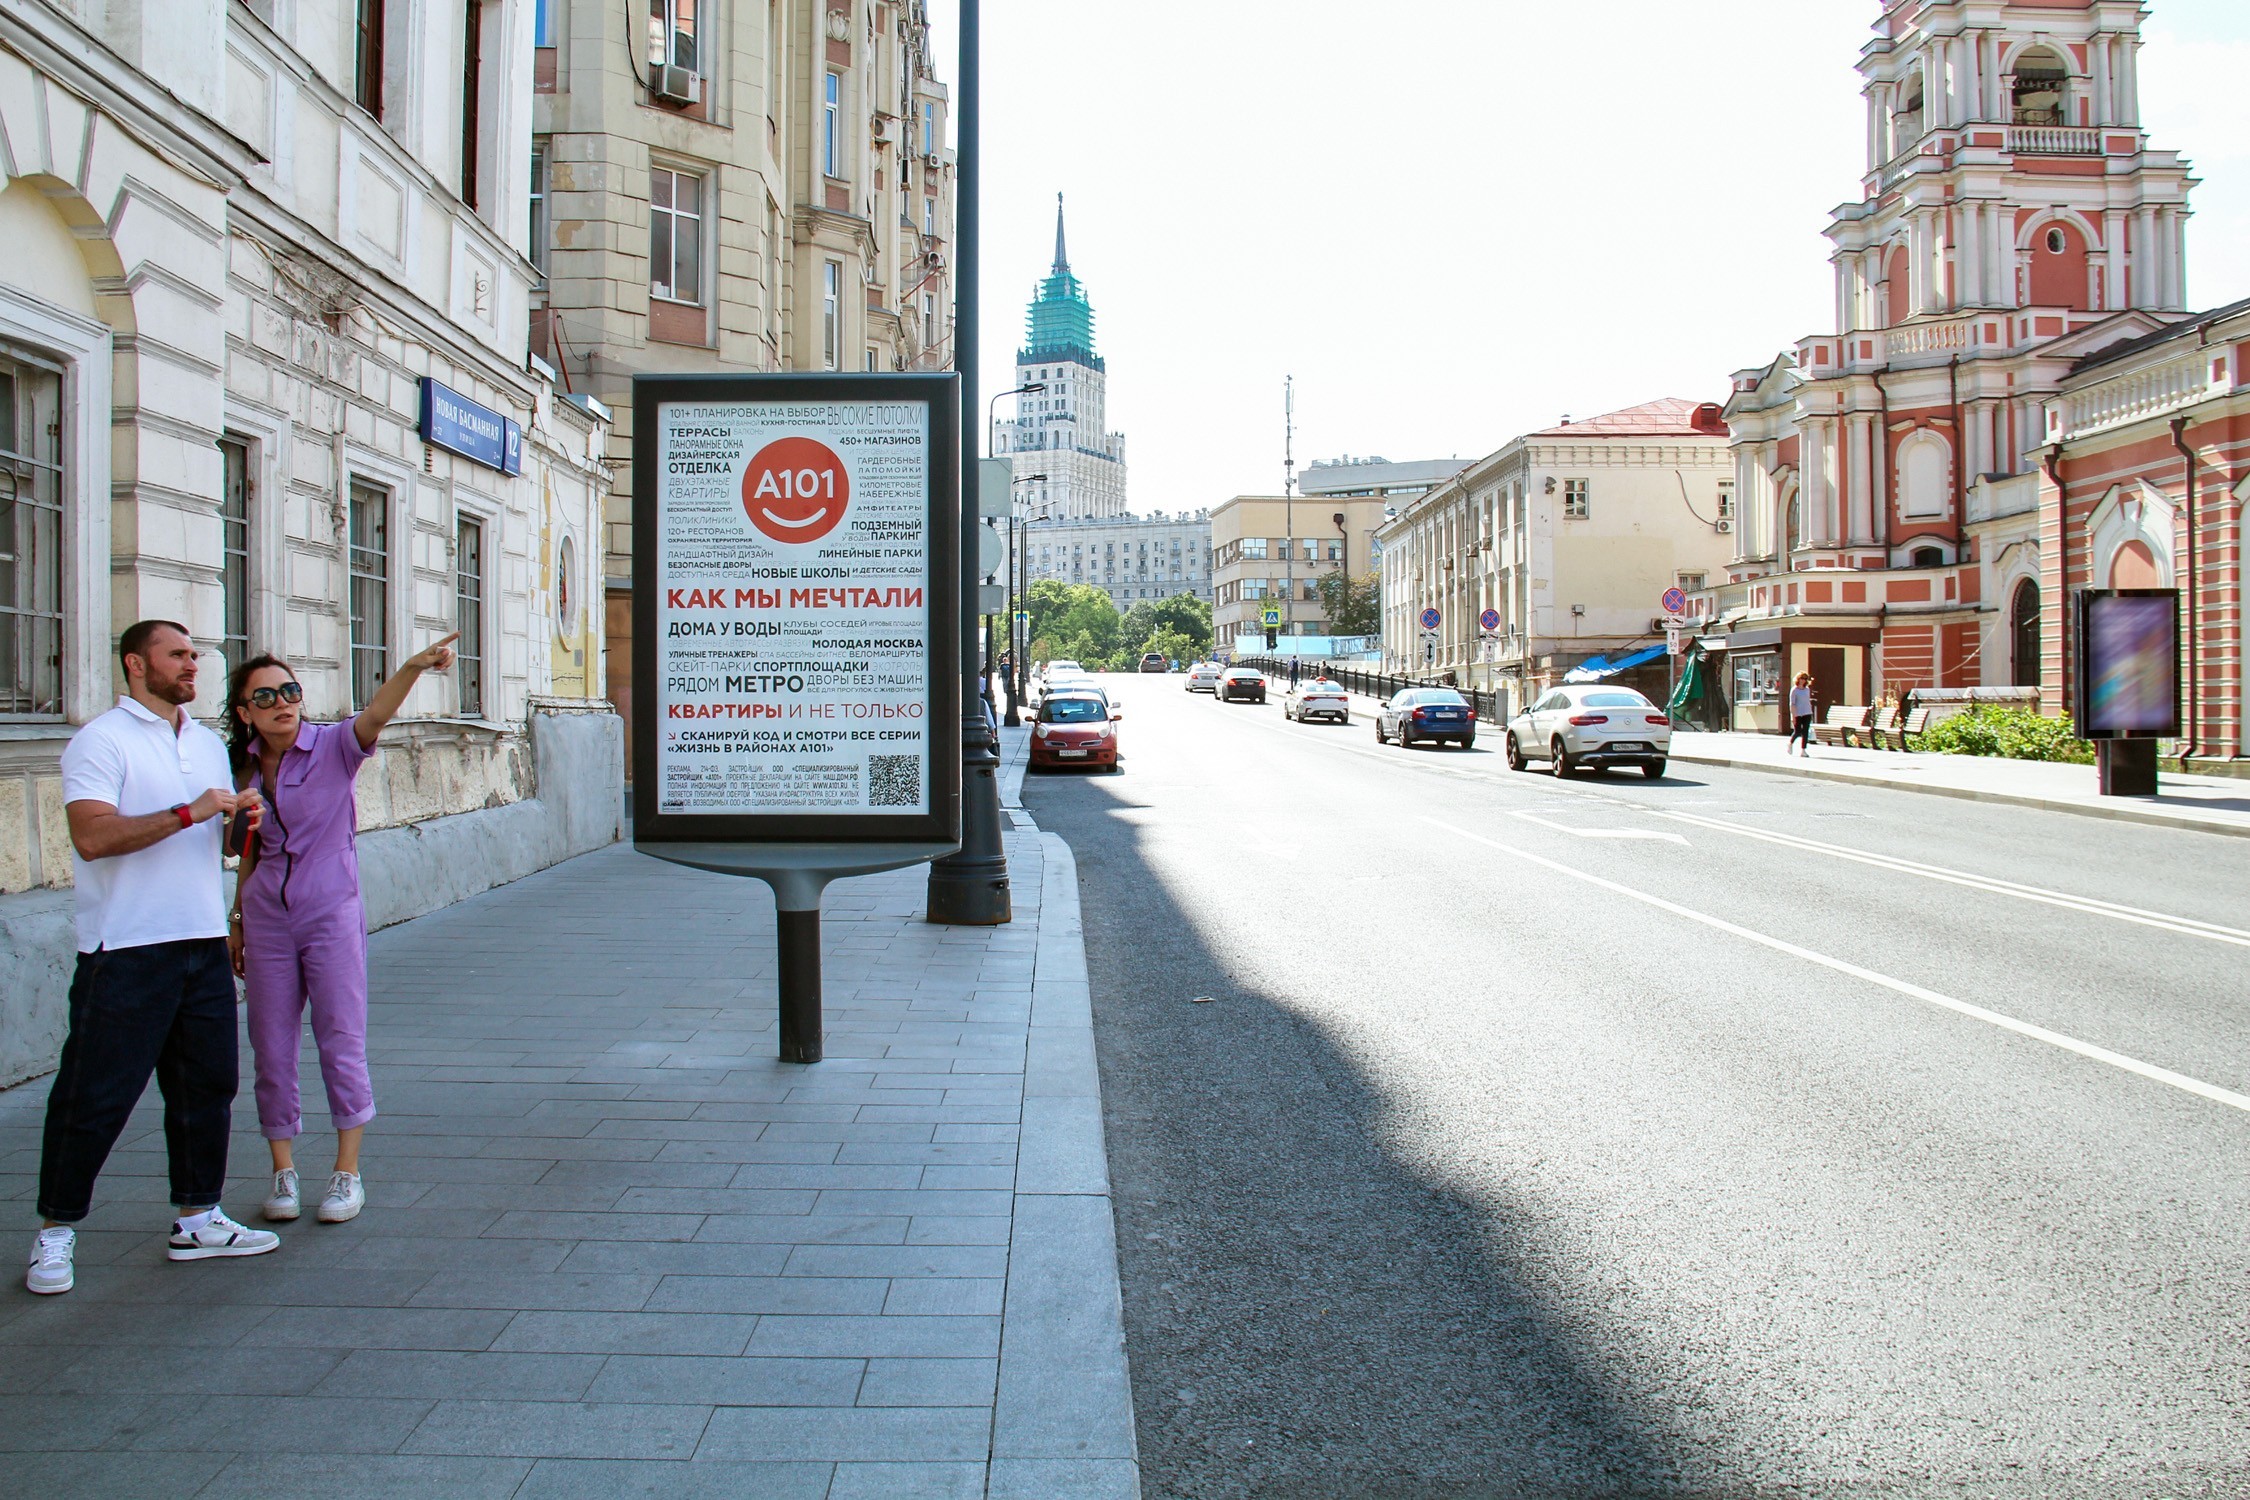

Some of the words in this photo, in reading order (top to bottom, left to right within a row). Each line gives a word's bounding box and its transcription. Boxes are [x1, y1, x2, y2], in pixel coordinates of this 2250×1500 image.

[670, 409, 690, 418] 101+
[693, 408, 766, 418] ПЛАНИРОВКА
[770, 408, 783, 417] НА
[788, 407, 825, 417] ВЫБОР
[828, 406, 873, 425] ВЫСОКИЕ
[877, 406, 922, 425] ПОТОЛКИ
[436, 396, 458, 424] НОВАЯ
[459, 407, 499, 442] БАСМАННАЯ
[669, 428, 731, 437] ТЕРРАСЫ
[459, 432, 476, 446] УЛИЦА
[509, 430, 518, 457] 12
[840, 437, 862, 445] 450+
[864, 437, 921, 445] МАГАЗИНОВ
[670, 440, 721, 449] ПАНОРАМНЫЕ
[723, 440, 744, 449] ОКНА
[668, 450, 740, 460] ДИЗАЙНЕРСКАЯ
[858, 457, 921, 465] ГАРДЕРОБНЫЕ
[669, 463, 732, 475] ОТДЕЛКА
[858, 465, 921, 474] ЛАПОМОЙКИ
[669, 478, 730, 486] ДВУХЭТАЖНЫЕ
[669, 488, 730, 498] КВАРТИРЫ
[860, 490, 922, 498] НАБЕРЕЖНЫЕ
[851, 519, 922, 531] ПОДЗЕМНЫЙ
[871, 532, 922, 540] ПАРКИНГ
[668, 550, 736, 559] ЛАНДШАФТНЫЙ
[738, 550, 774, 559] ДИЗАЙН
[818, 547, 881, 558] ЛИНЕЙНЫЕ
[884, 549, 922, 558] ПАРКИ
[723, 562, 752, 570] ДВОРЫ
[898, 566, 922, 574] САДЫ
[668, 571, 720, 579] ДОСТУПНАЯ
[722, 571, 750, 579] СРЕДА
[752, 568, 797, 578] НОВЫЕ
[801, 567, 849, 578] ШКОЛЫ
[668, 588, 727, 608] КАК
[735, 588, 781, 608] МЫ
[790, 587, 922, 608] МЕЧТАЛИ
[820, 619, 867, 629] СОСЕДЕЙ
[669, 621, 716, 638] ДОМА
[720, 622, 730, 635] У
[734, 621, 780, 638] ВОДЫ
[812, 639, 870, 649] МОЛОДАЯ
[874, 639, 923, 648] МОСКВА
[708, 650, 758, 658] ТРЕНАЖЕРЫ
[668, 660, 751, 672] СКЕЙТ-ПАРКИ
[754, 661, 869, 673] СПОРТПЛОЩАДКИ
[873, 662, 922, 671] ЭКОТРОПЫ
[668, 677, 719, 694] РЯДОМ
[726, 675, 804, 693] МЕТРО
[807, 675, 849, 686] ДВОРЫ
[853, 675, 874, 685] БЕЗ
[878, 675, 922, 685] МАШИН
[668, 704, 782, 718] КВАРТИРЫ
[789, 704, 802, 718] И
[810, 704, 835, 718] НЕ
[841, 702, 923, 718] ТОЛЬКО
[681, 730, 749, 740] СКАНИРУЙ
[753, 732, 780, 741] КОД
[784, 732, 792, 740] И
[796, 731, 847, 740] СМОТРИ
[852, 731, 875, 740] ВСЕ
[879, 731, 921, 740] СЕРИИ
[668, 744, 720, 753] «ЖИЗНЬ
[724, 744, 732, 752] В
[736, 742, 796, 753] РАЙОНАХ
[800, 743, 834, 752] А101»
[667, 773, 703, 781] ЗАСТРОЙЩИК
